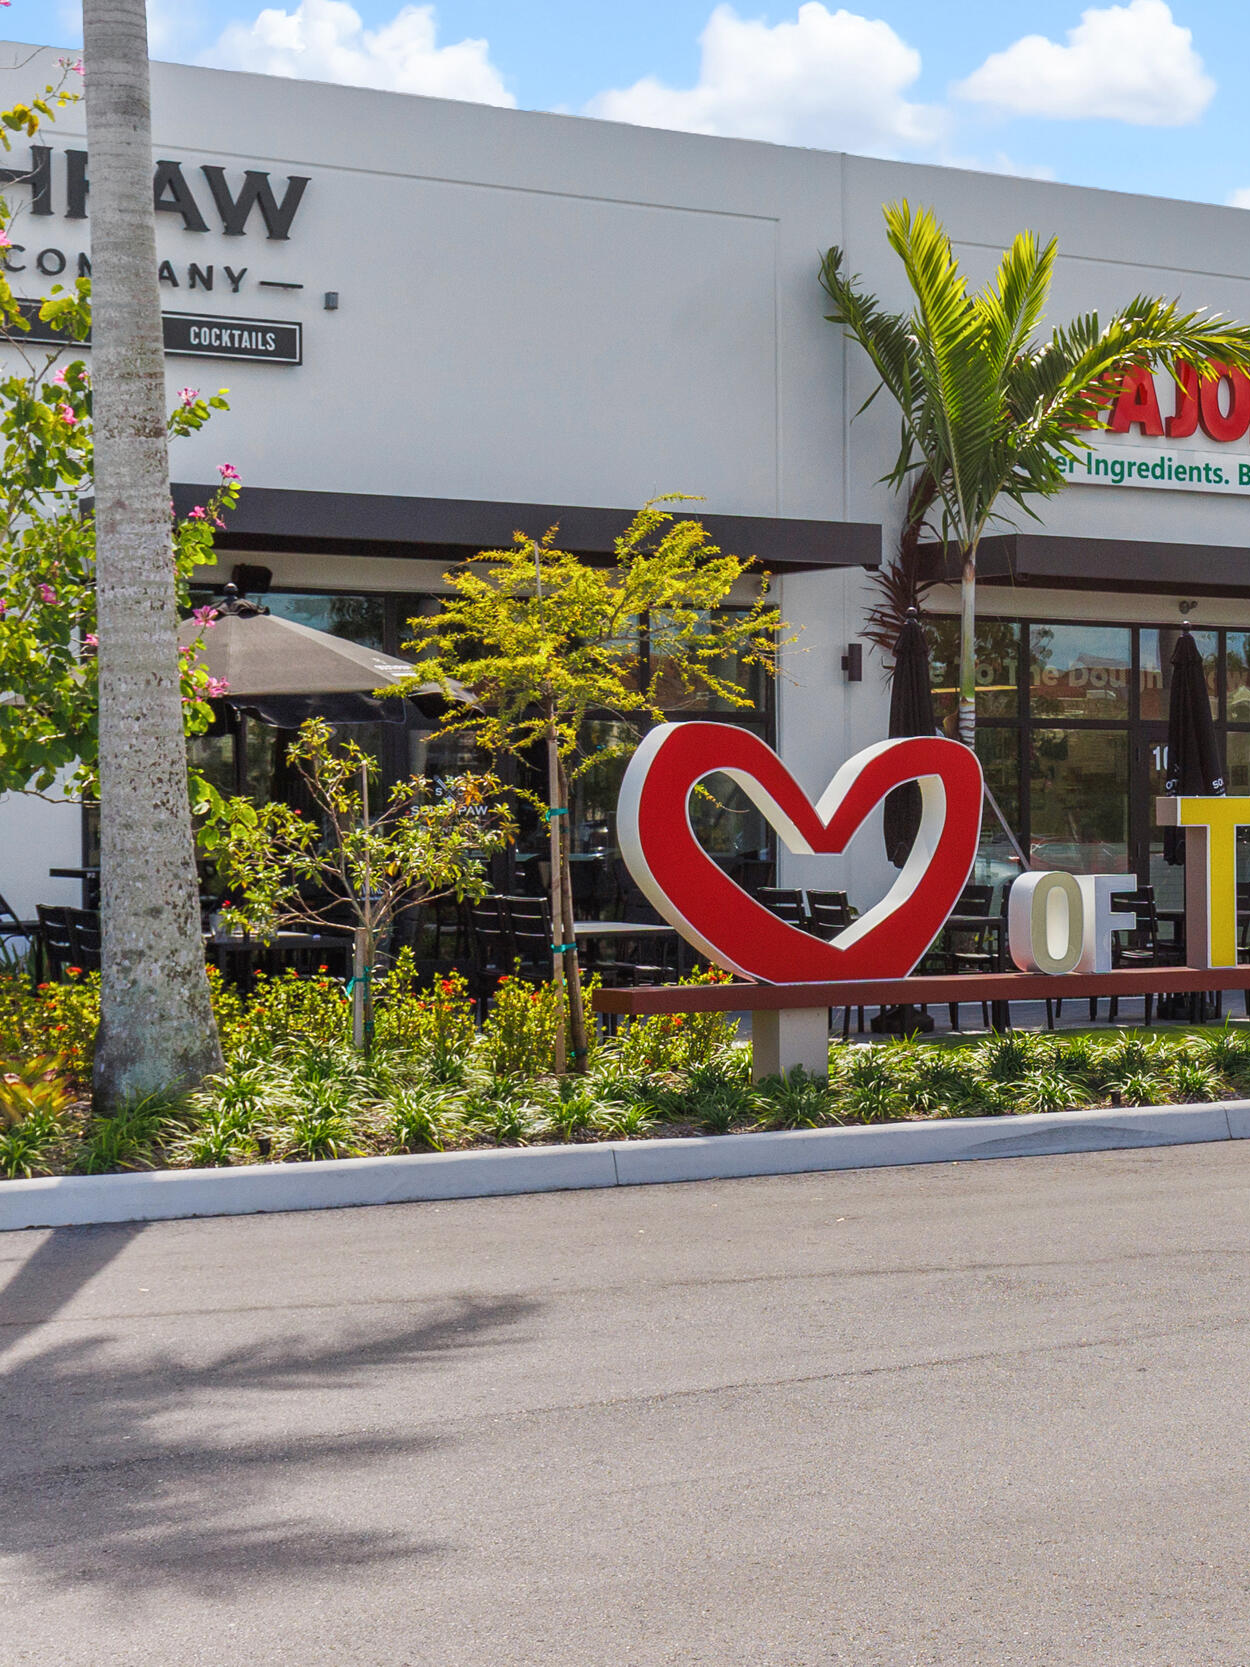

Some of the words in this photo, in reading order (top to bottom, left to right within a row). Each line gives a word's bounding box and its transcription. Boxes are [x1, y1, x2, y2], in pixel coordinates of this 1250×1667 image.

[3, 244, 248, 293] COANY
[190, 326, 276, 352] COCKTAILS
[1086, 452, 1230, 485] Ingredients.
[1009, 871, 1138, 975] OF
